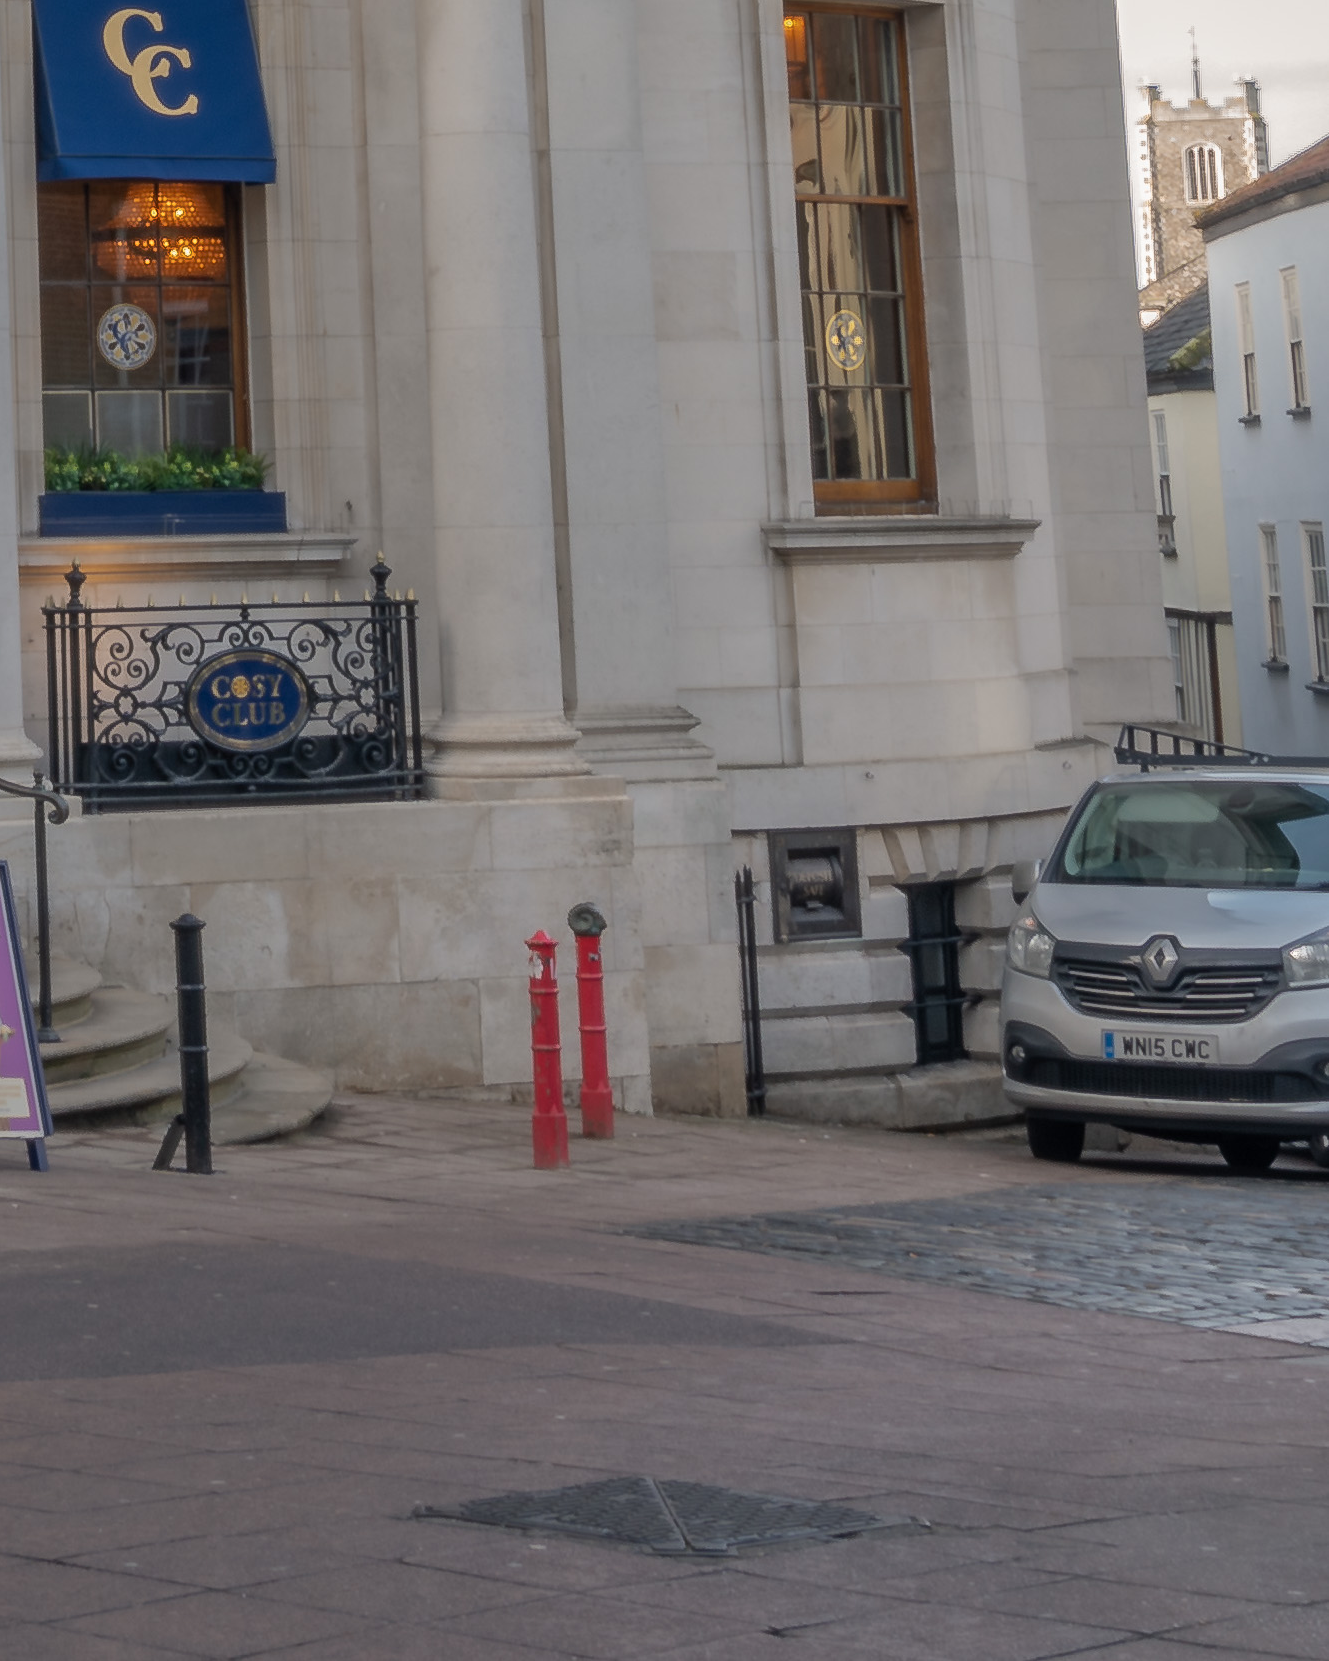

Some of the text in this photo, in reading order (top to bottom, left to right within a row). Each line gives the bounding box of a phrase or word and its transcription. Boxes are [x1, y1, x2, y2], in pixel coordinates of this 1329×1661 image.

[211, 674, 283, 699] COSY
[211, 701, 286, 727] CLUB
[1122, 1037, 1210, 1059] WN15 CWC
